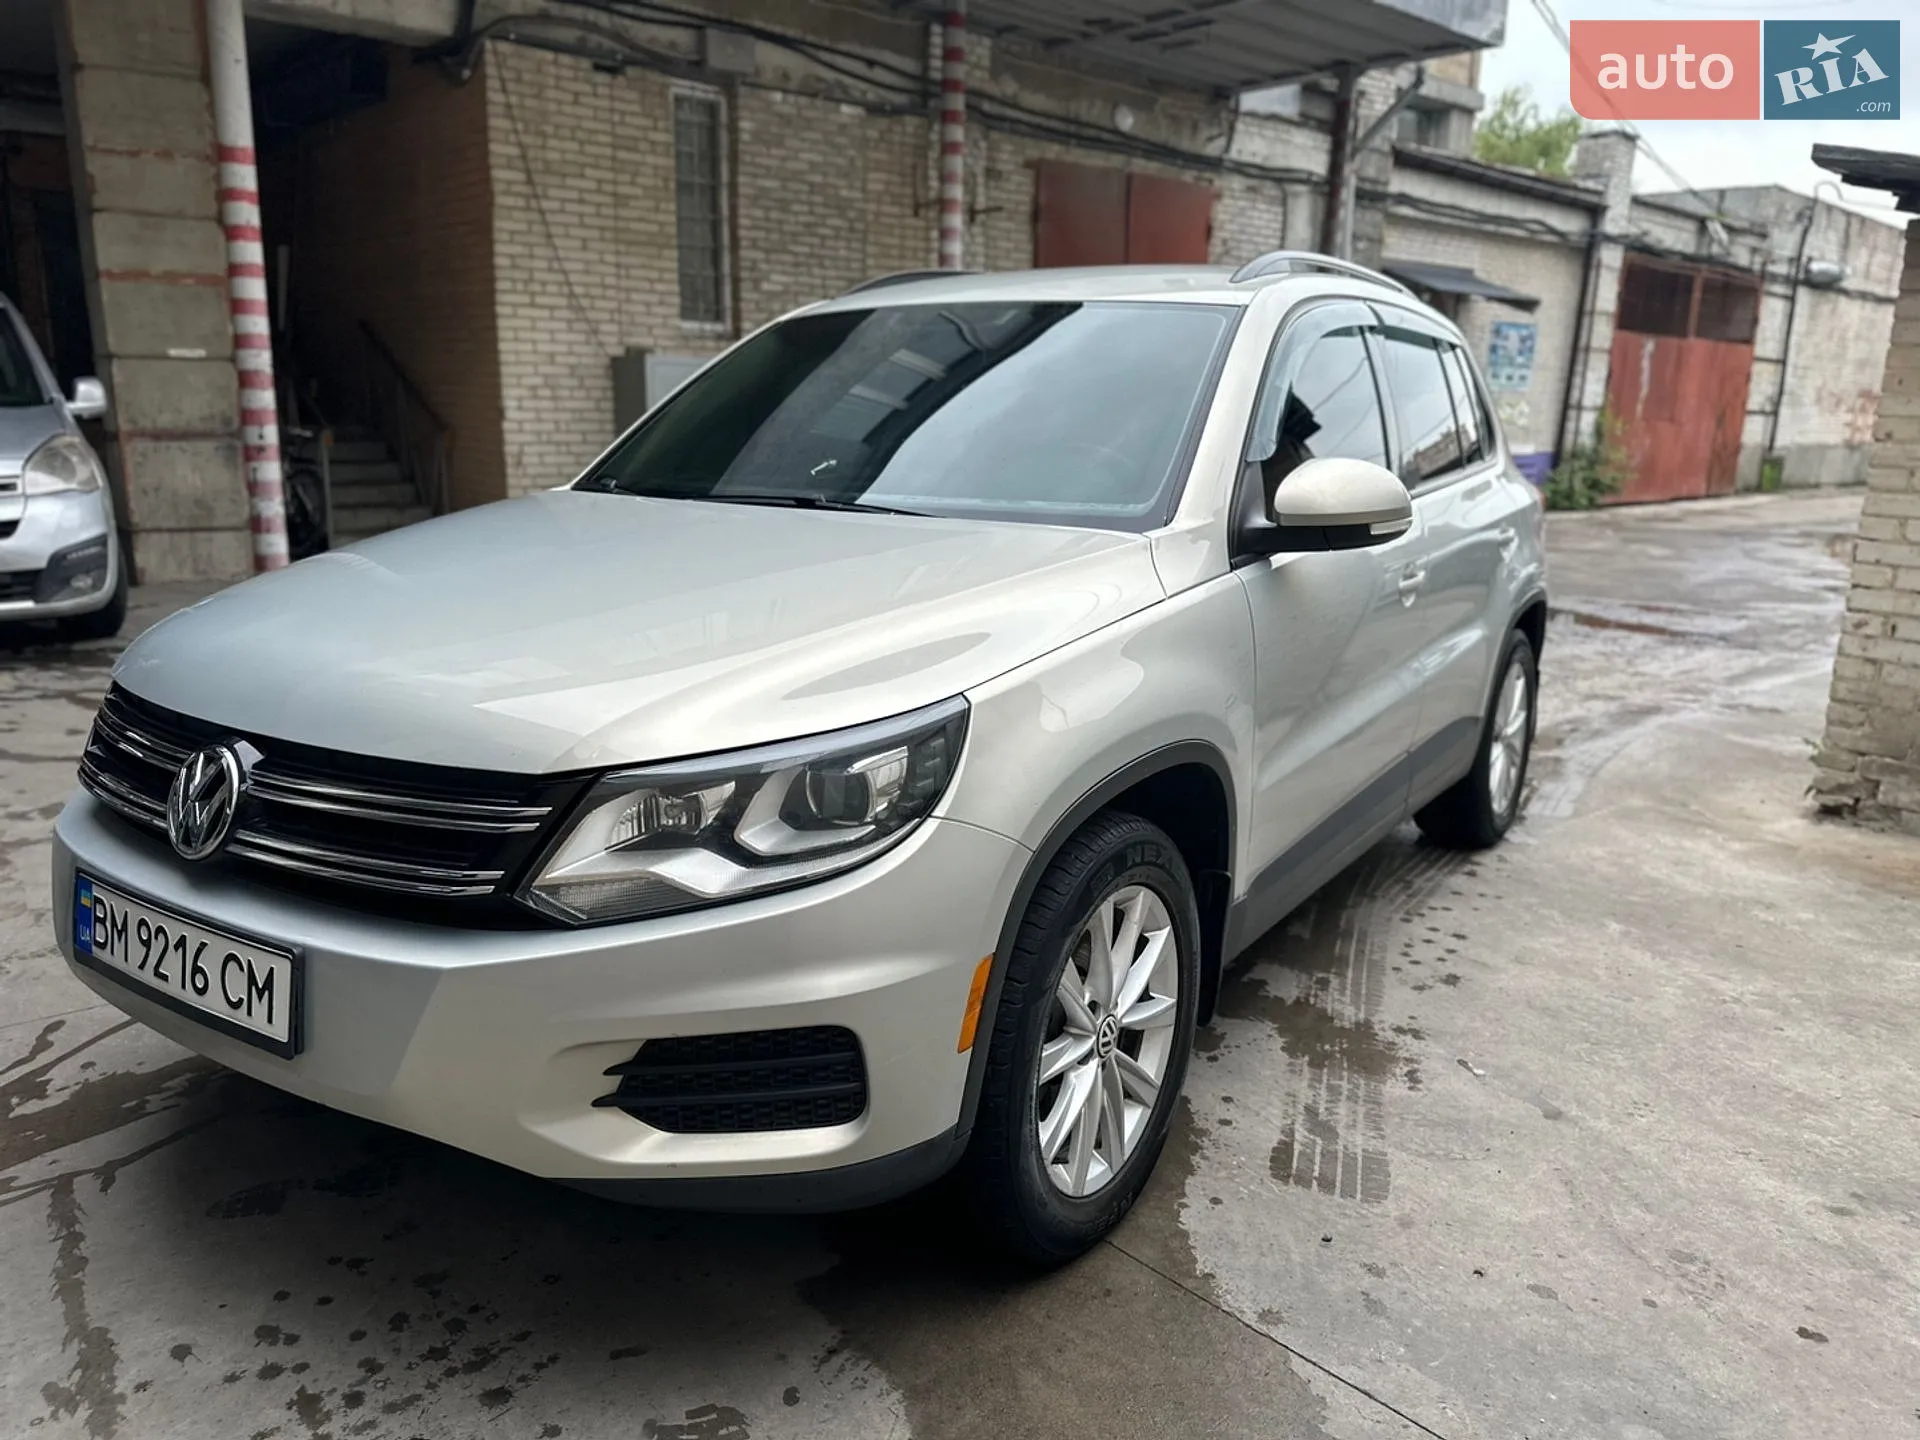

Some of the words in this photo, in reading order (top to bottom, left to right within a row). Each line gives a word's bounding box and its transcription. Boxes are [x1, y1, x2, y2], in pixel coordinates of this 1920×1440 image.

[93, 893, 129, 963] BM
[136, 916, 211, 997] 9216
[221, 950, 275, 1025] CM
